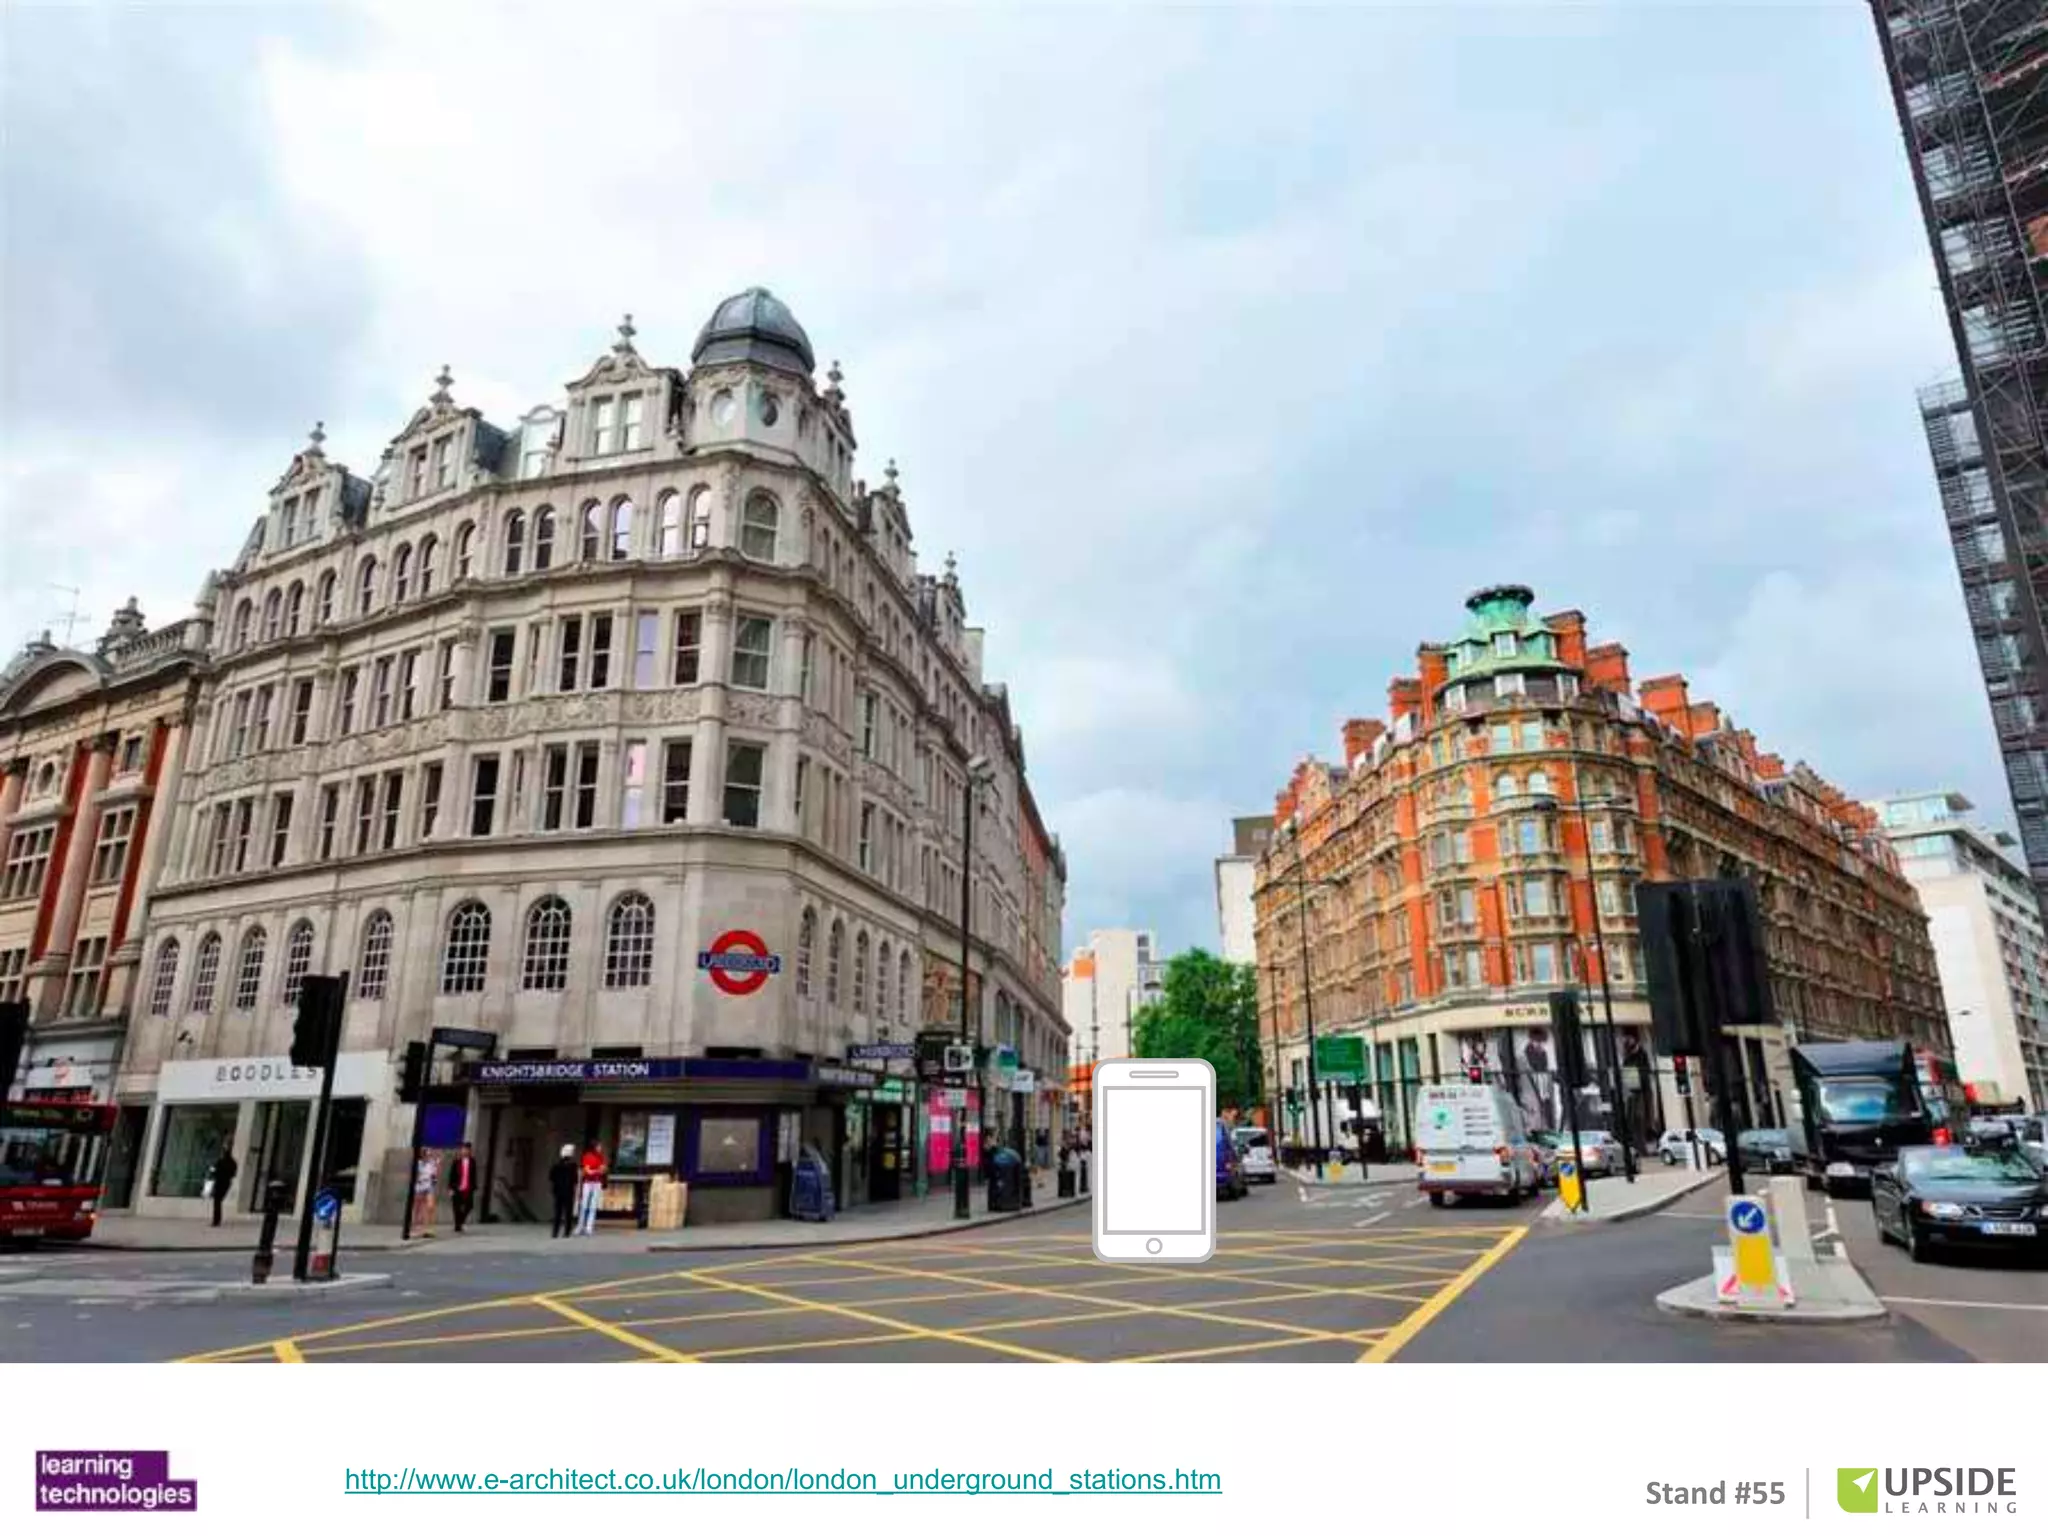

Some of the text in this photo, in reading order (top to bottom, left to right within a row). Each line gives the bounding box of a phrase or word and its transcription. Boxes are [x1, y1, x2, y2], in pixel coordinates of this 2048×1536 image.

[216, 1064, 317, 1081] BOODLES
[481, 1062, 649, 1077] KNIGHTSBRIDGE STATION
